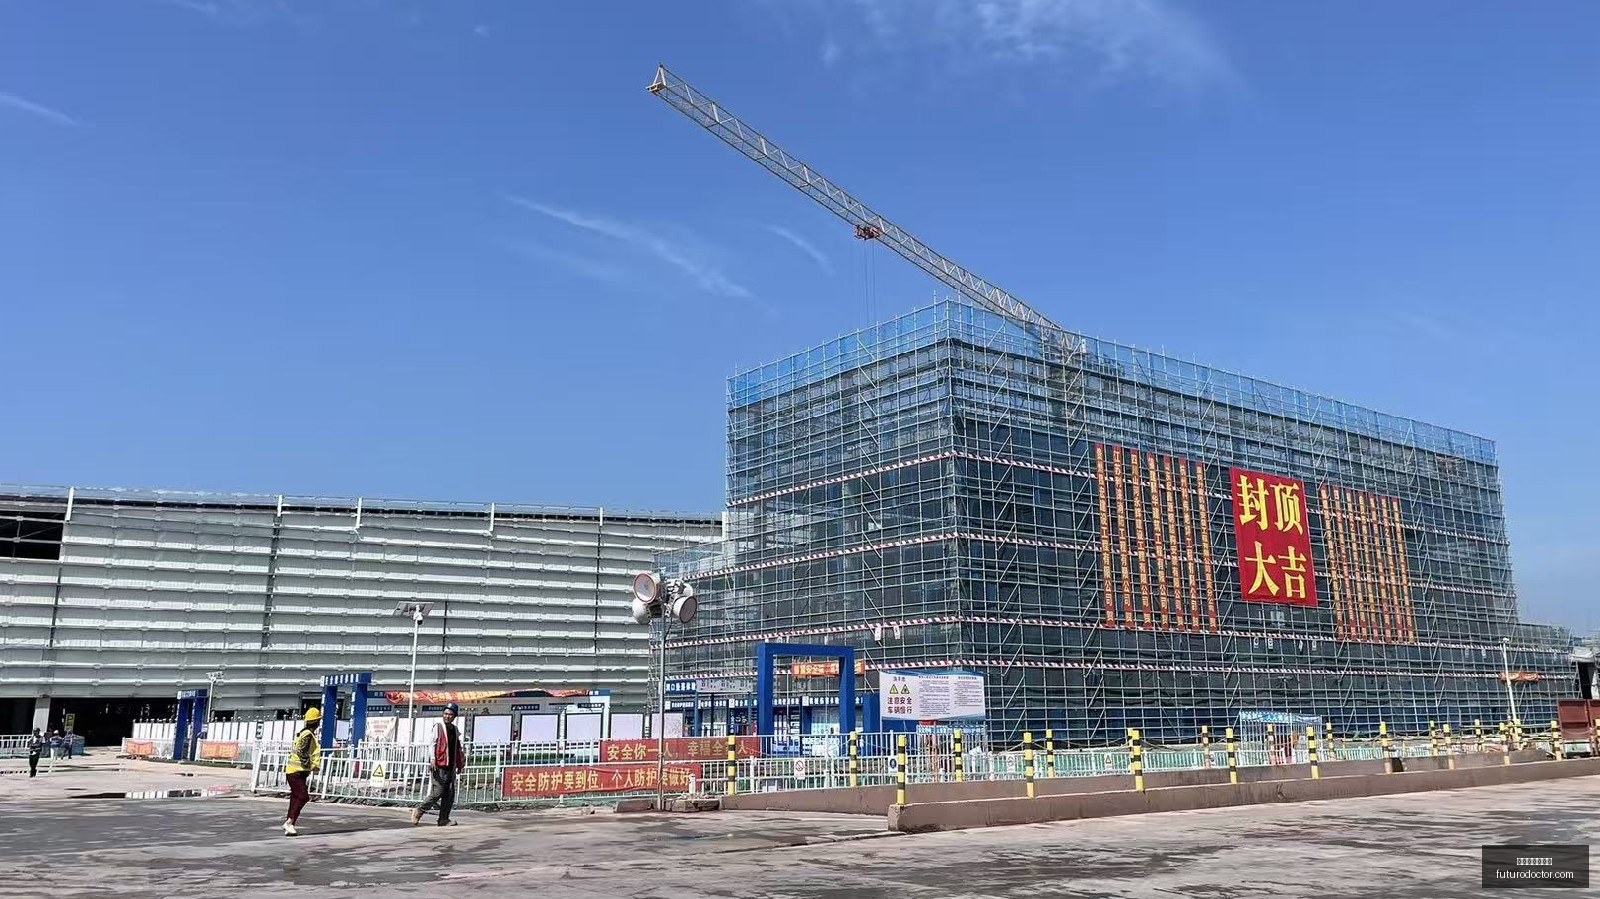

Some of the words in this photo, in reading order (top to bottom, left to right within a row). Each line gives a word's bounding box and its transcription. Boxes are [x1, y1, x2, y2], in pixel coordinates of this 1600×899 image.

[1237, 474, 1303, 535] 封顶
[1245, 541, 1306, 598] 大吉
[888, 696, 913, 705] 注意安全
[888, 706, 913, 714] 车辆慢行
